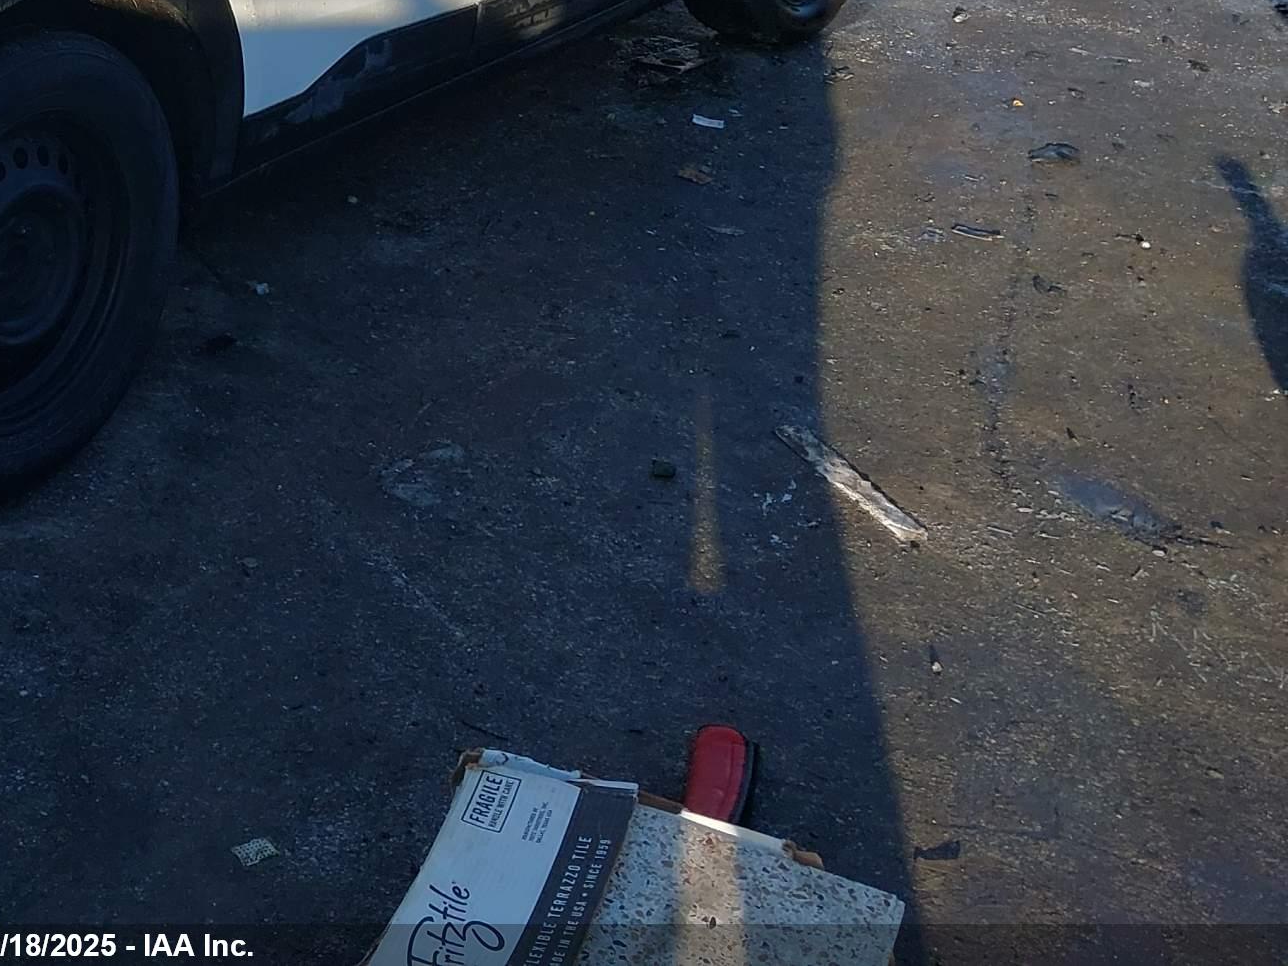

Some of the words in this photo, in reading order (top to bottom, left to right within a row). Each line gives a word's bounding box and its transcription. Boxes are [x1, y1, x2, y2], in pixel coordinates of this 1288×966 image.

[469, 775, 503, 824] FRAGILE
[594, 839, 611, 859] 1959
[583, 864, 603, 889] SINCE
[523, 922, 557, 966] LEXIBLE
[547, 865, 581, 918] TERRAZZO
[572, 836, 592, 860] TILE
[571, 901, 588, 917] USA
[563, 921, 579, 935] THE
[557, 939, 571, 948] IN
